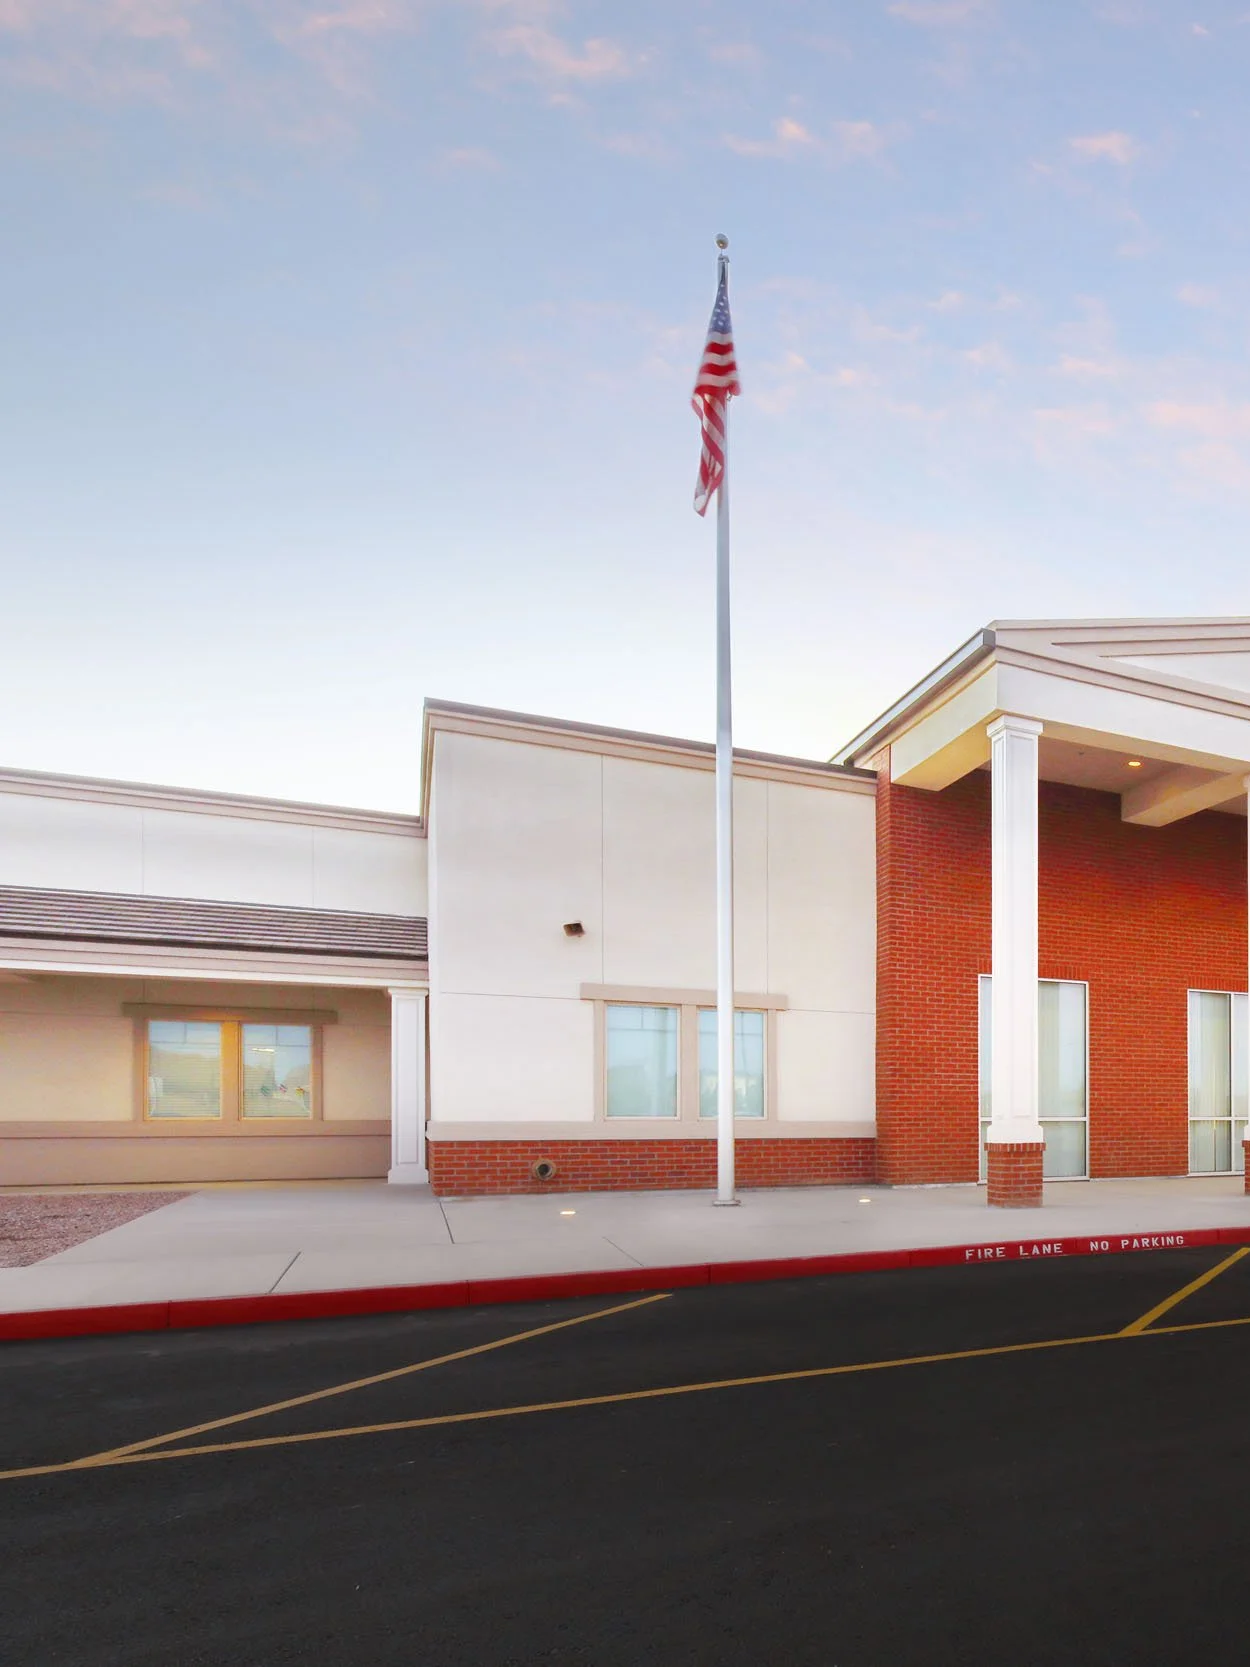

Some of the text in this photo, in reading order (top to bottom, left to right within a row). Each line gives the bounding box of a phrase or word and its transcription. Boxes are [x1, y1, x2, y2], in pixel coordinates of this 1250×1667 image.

[965, 1235, 1185, 1260] FIRE LANE NO PARKING
